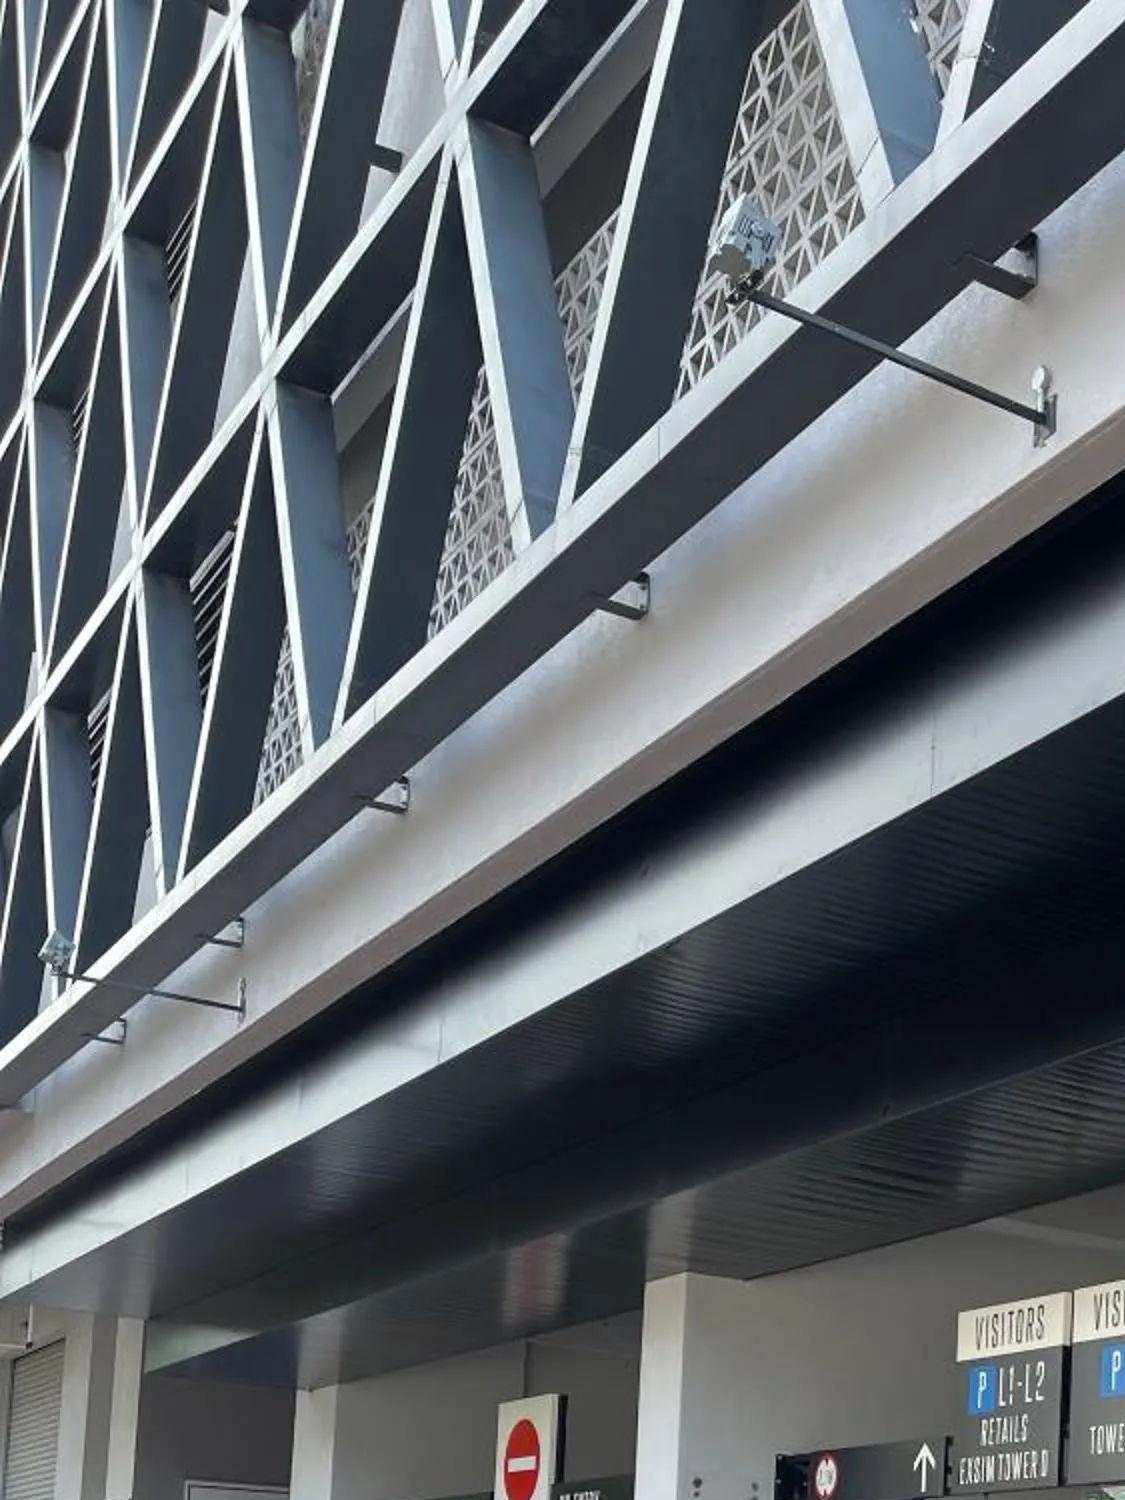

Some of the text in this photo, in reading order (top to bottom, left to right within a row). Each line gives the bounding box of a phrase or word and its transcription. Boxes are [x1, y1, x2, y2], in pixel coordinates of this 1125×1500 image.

[975, 1304, 1045, 1350] VISITORS
[977, 1361, 1045, 1408] P L1-L2
[1111, 1351, 1121, 1390] P
[980, 1414, 1028, 1446] RETAILS
[959, 1456, 995, 1484] EXSIM
[998, 1451, 1037, 1481] TOWER
